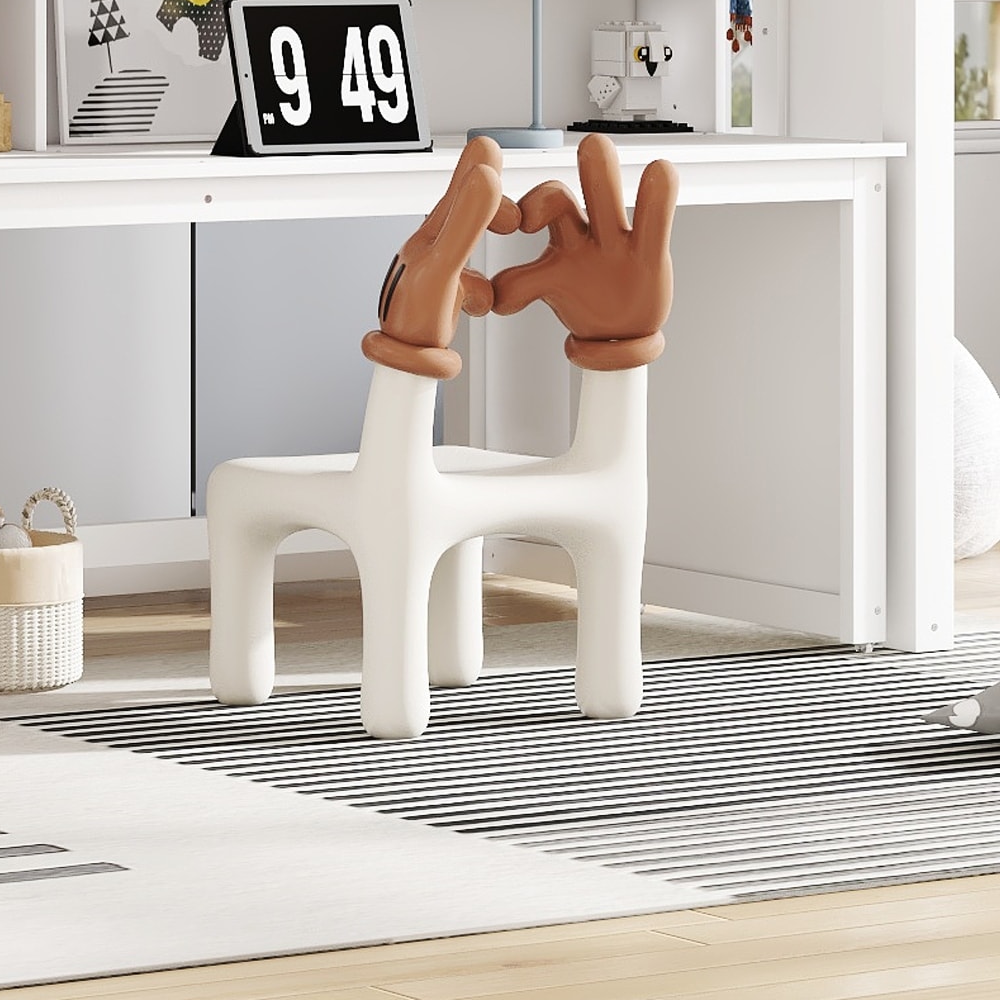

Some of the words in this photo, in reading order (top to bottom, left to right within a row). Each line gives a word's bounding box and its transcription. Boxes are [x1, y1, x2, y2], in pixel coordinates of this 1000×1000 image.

[270, 25, 312, 126] 9
[341, 24, 409, 124] 49
[262, 112, 275, 125] PM
